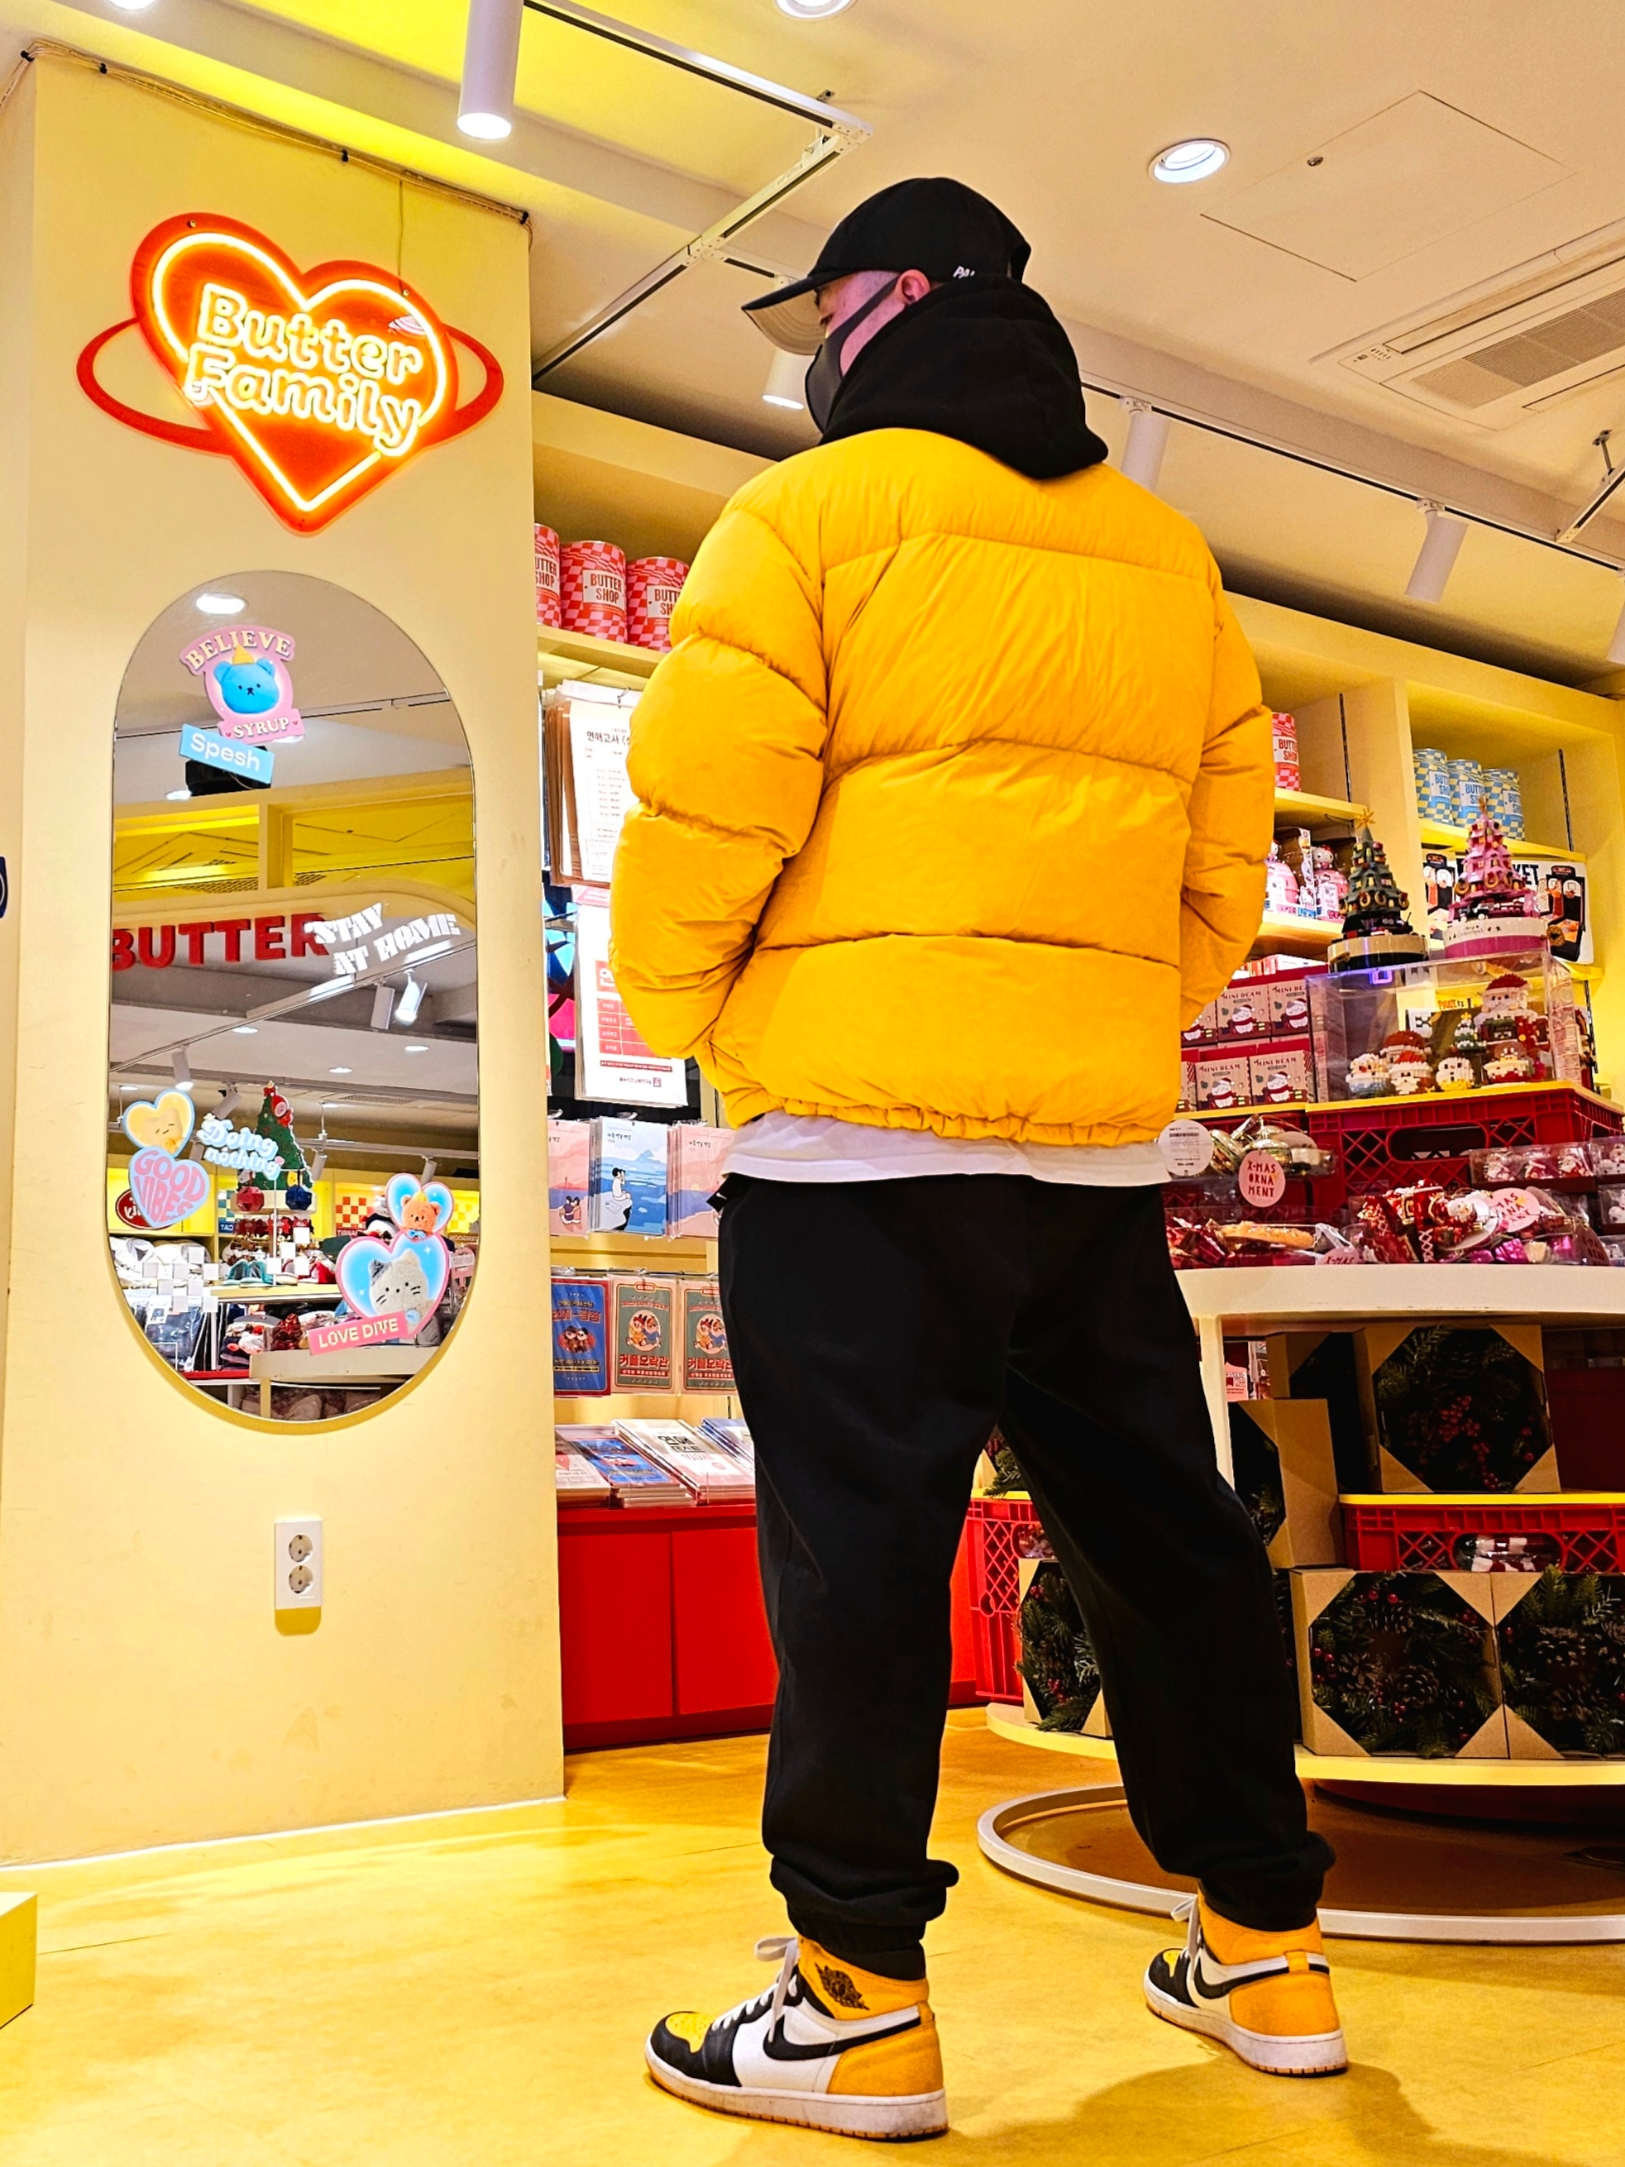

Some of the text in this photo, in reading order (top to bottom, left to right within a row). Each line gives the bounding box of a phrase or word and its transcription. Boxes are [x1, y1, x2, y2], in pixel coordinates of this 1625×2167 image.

[197, 282, 424, 385] Butter
[184, 342, 421, 457] Family
[536, 557, 557, 576] UTTER
[590, 573, 622, 593] BUTTER
[595, 588, 620, 604] SHOP
[654, 588, 681, 603] BUTT
[660, 602, 675, 615] SH
[185, 630, 291, 671] BELIEVE
[233, 717, 290, 738] SYRUP
[190, 732, 260, 771] Spesh
[304, 902, 384, 944] STAY
[112, 912, 330, 972] BUTTER
[333, 913, 462, 976] AT HOME
[196, 1118, 278, 1161] Doing
[134, 1150, 206, 1202] GOOD
[203, 1146, 282, 1181] nothing
[1247, 1161, 1276, 1173] X-MAS
[1248, 1173, 1274, 1186] ORNA
[133, 1175, 194, 1223] VIBES
[1248, 1185, 1275, 1198] MENT
[318, 1318, 399, 1348] LOVE DIVE
